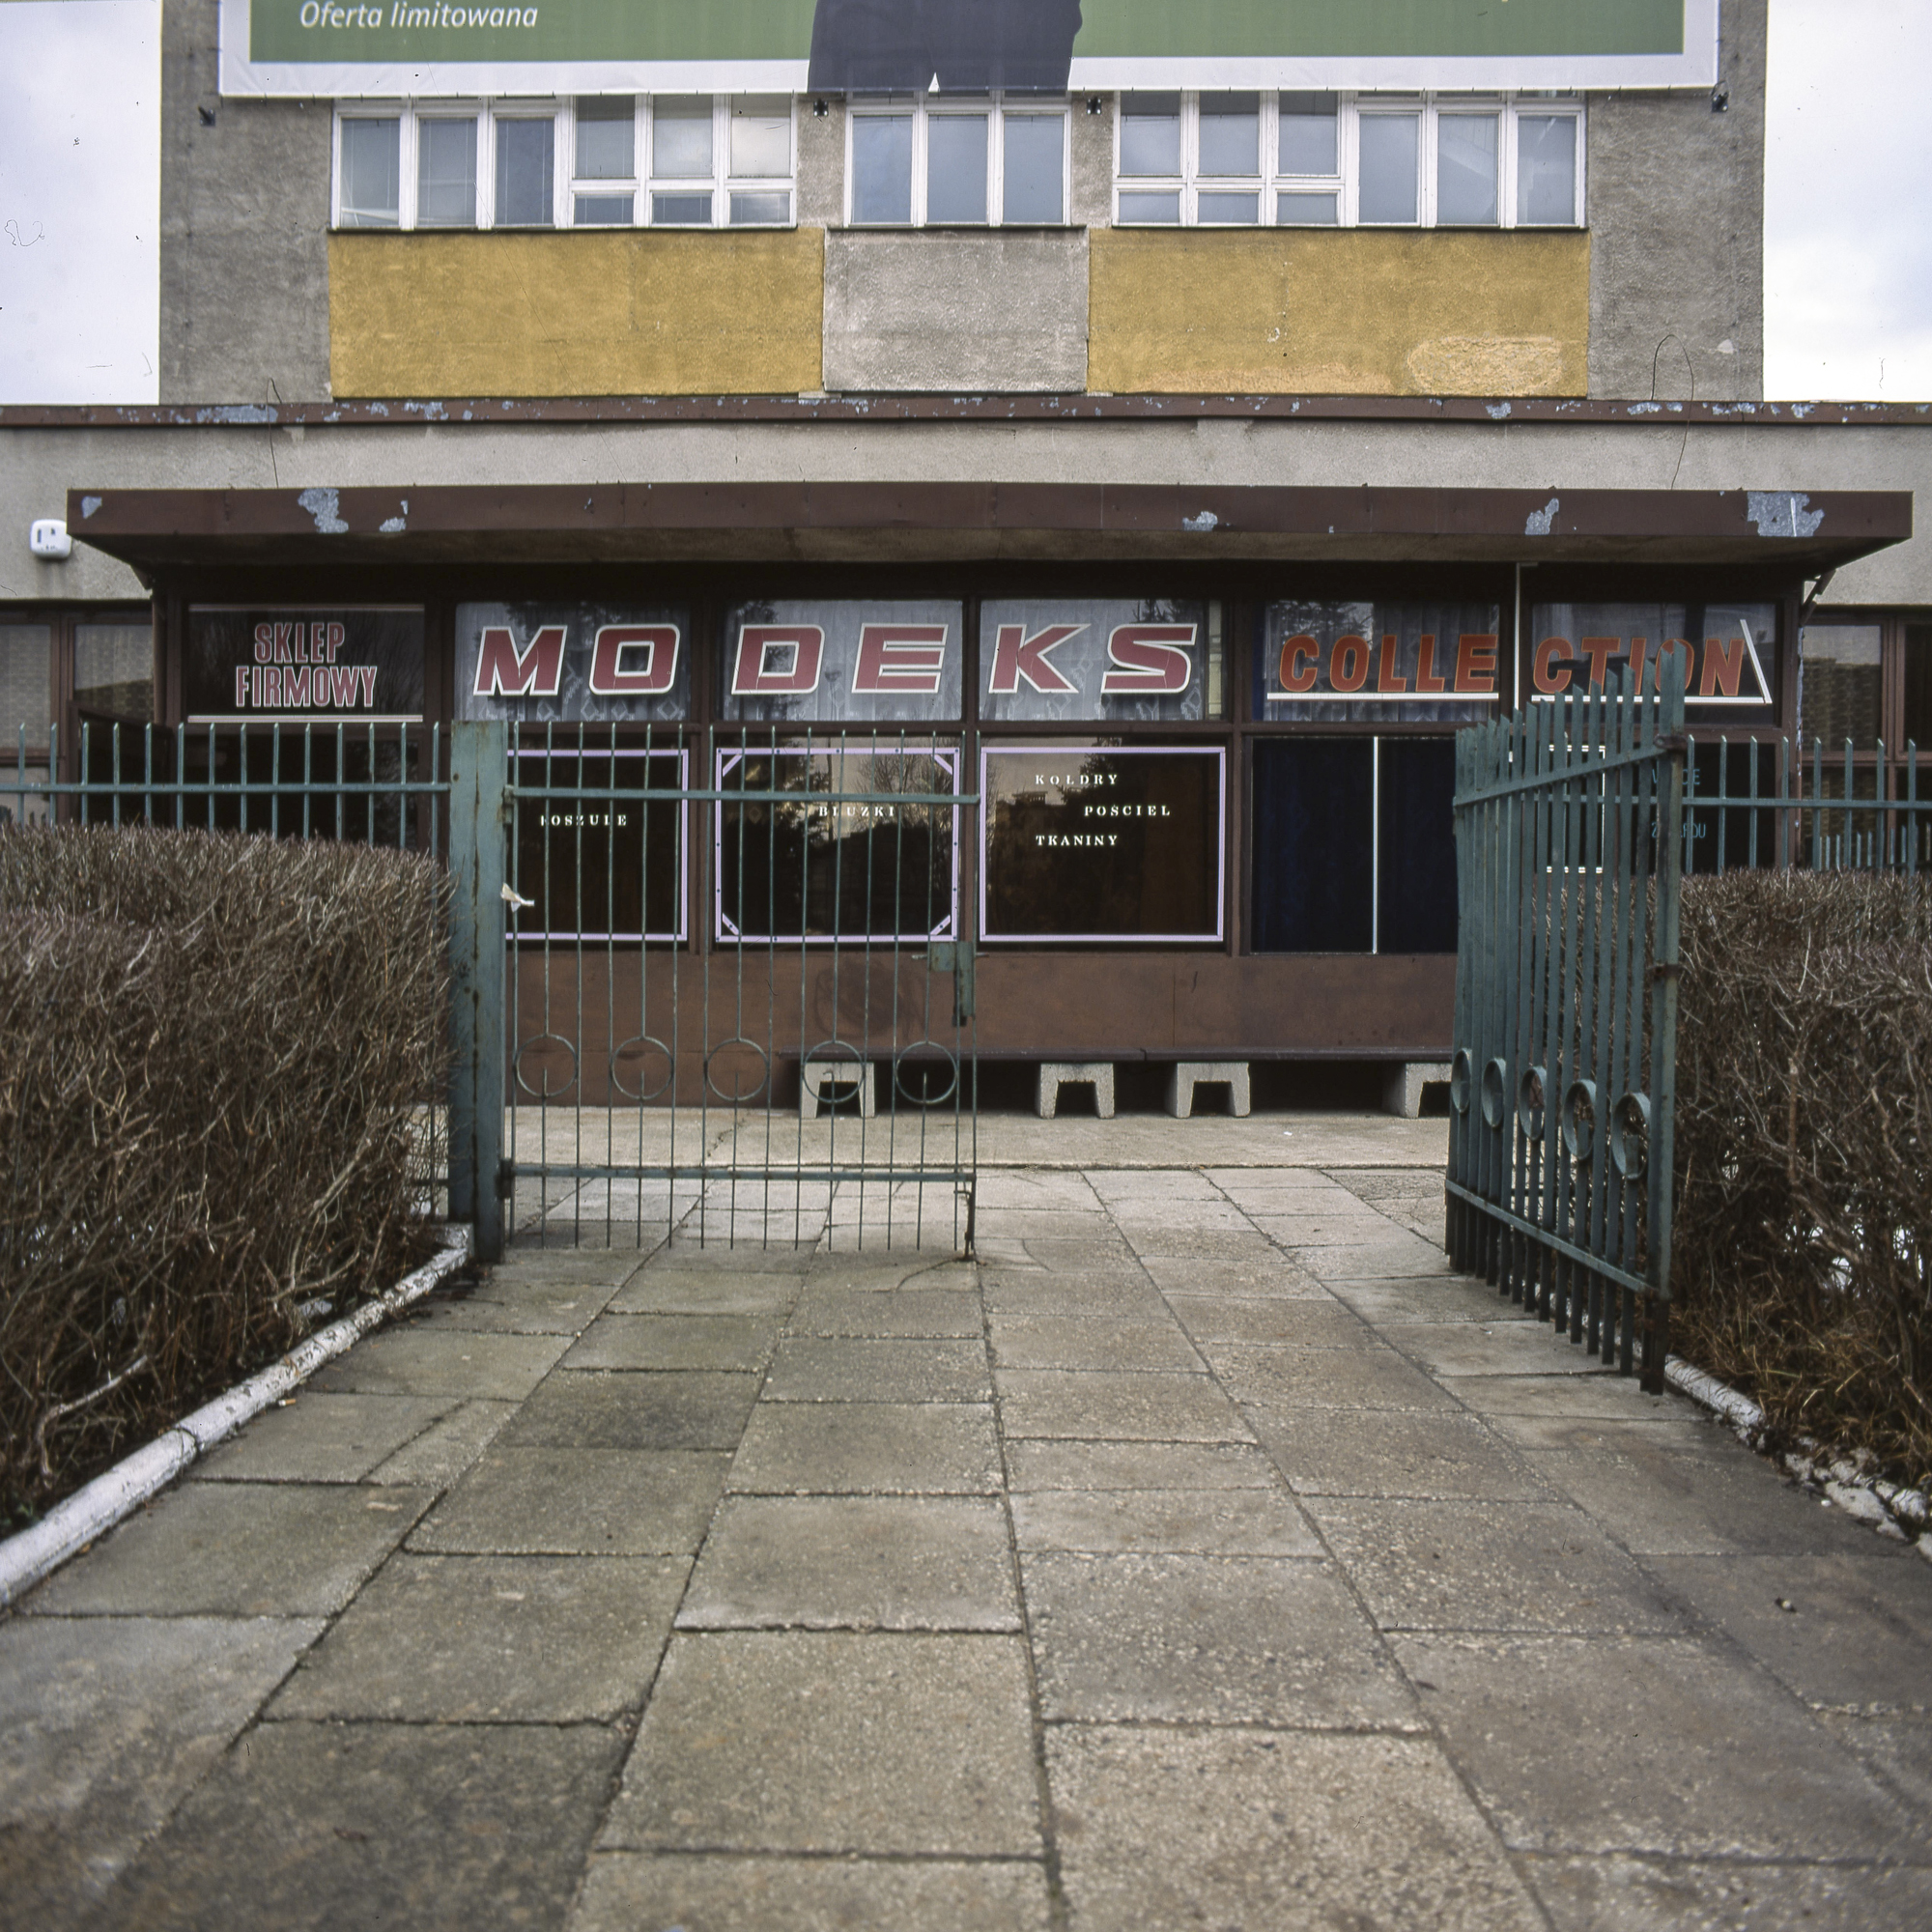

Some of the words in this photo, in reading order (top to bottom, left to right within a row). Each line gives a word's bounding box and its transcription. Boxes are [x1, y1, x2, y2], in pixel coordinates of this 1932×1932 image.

[299, 0, 383, 28] Oferta
[390, 0, 538, 28] limitowana
[253, 622, 346, 665] SKLEP
[473, 623, 1198, 696] MODEKS
[235, 666, 378, 708] FIRMOWY
[1036, 835, 1118, 846] TKANINY
